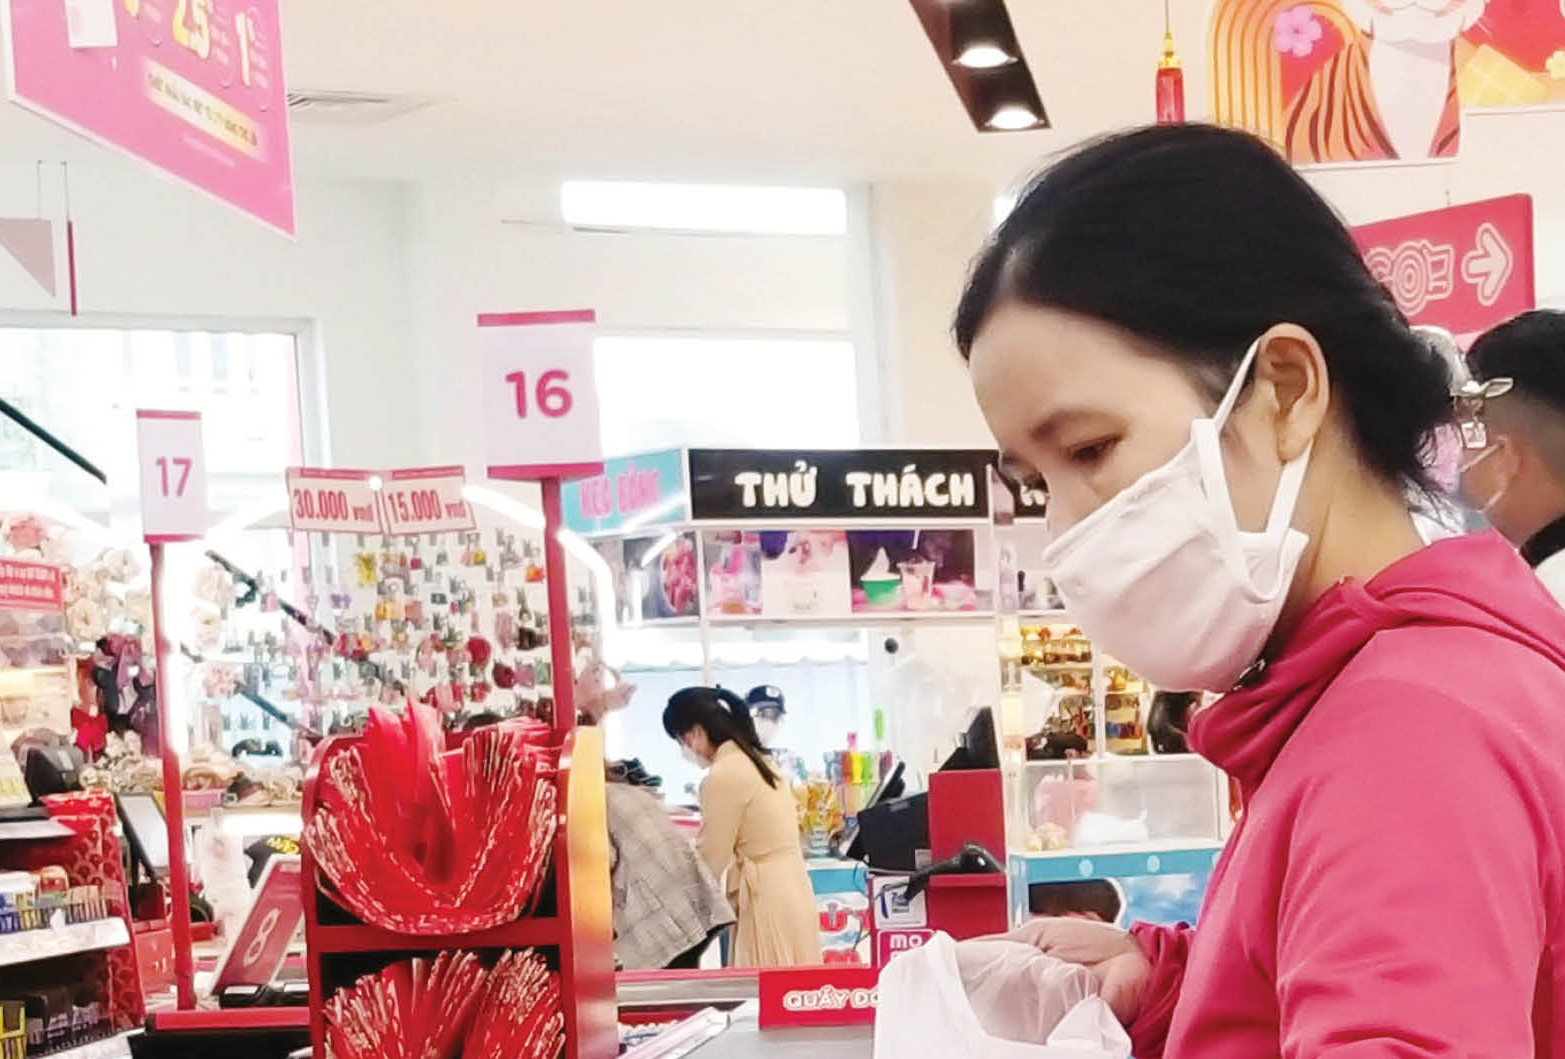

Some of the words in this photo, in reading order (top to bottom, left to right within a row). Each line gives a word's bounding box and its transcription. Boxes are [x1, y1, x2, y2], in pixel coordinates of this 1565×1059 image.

[505, 369, 573, 419] 16
[156, 457, 192, 497] 17
[734, 460, 818, 508] THỬ
[845, 463, 976, 508] THÁCH
[294, 489, 349, 521] 30.000
[388, 489, 442, 523] 15.000
